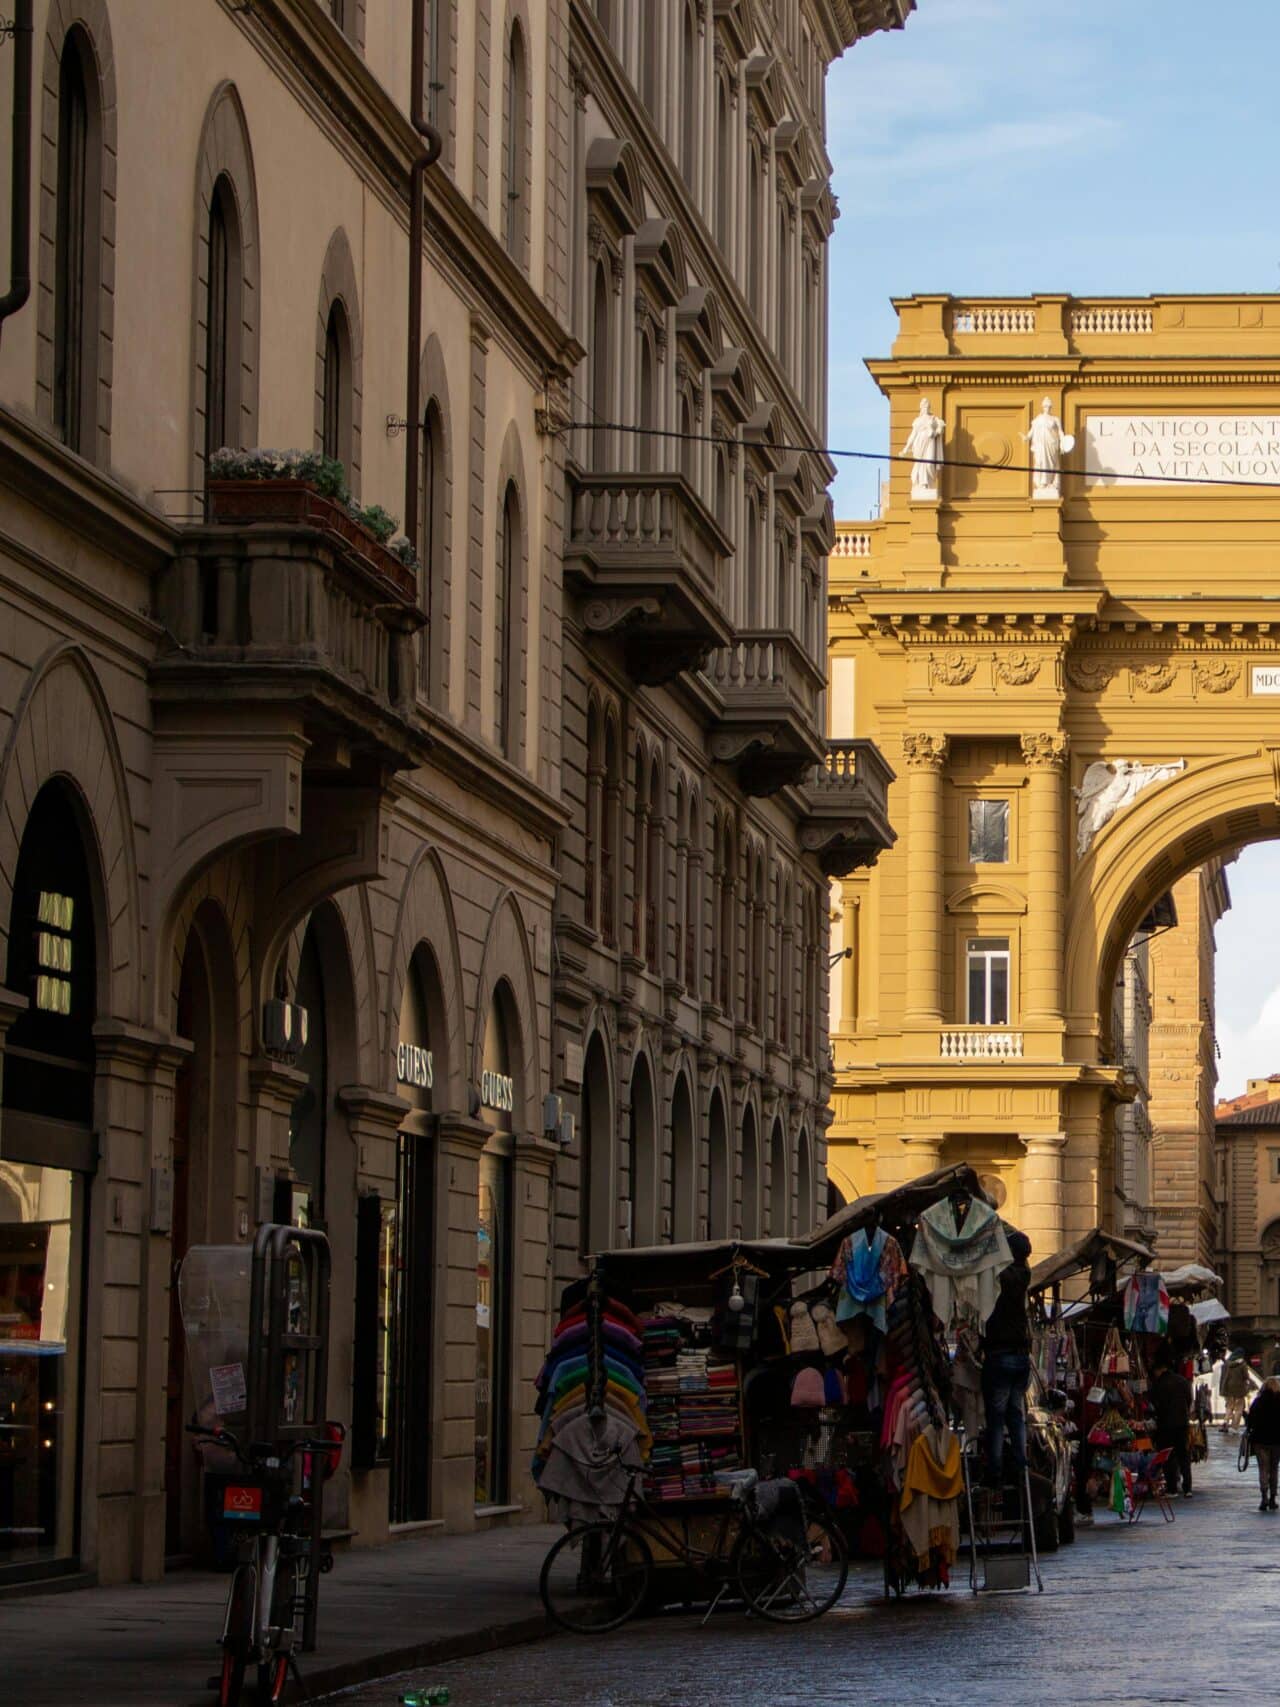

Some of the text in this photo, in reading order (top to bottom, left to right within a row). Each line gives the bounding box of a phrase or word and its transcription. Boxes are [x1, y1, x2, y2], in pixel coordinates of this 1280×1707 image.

[1132, 440, 1162, 457] DA
[1133, 461, 1145, 476] A
[1157, 460, 1210, 476] VITA
[396, 1041, 433, 1089] GUESS
[481, 1069, 514, 1112] GUESS
